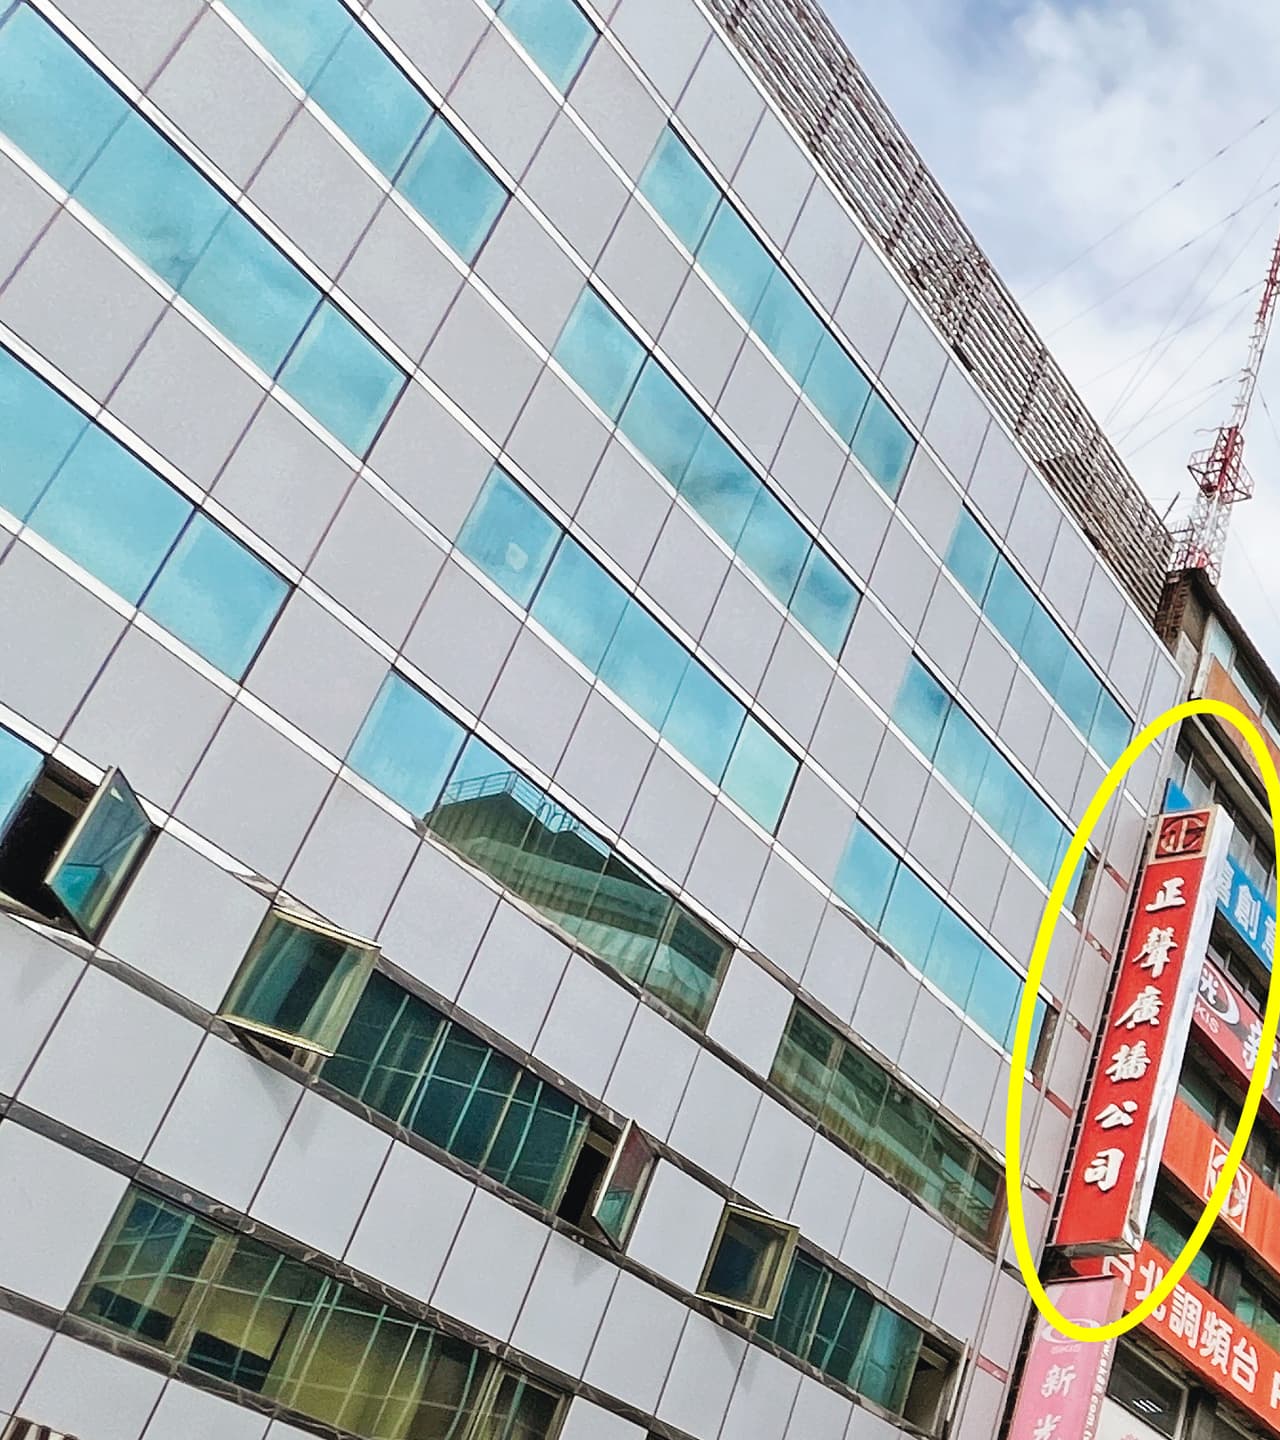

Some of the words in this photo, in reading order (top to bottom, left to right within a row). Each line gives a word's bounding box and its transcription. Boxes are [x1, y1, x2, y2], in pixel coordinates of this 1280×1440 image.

[1083, 876, 1186, 1192] 正聲廣播公司
